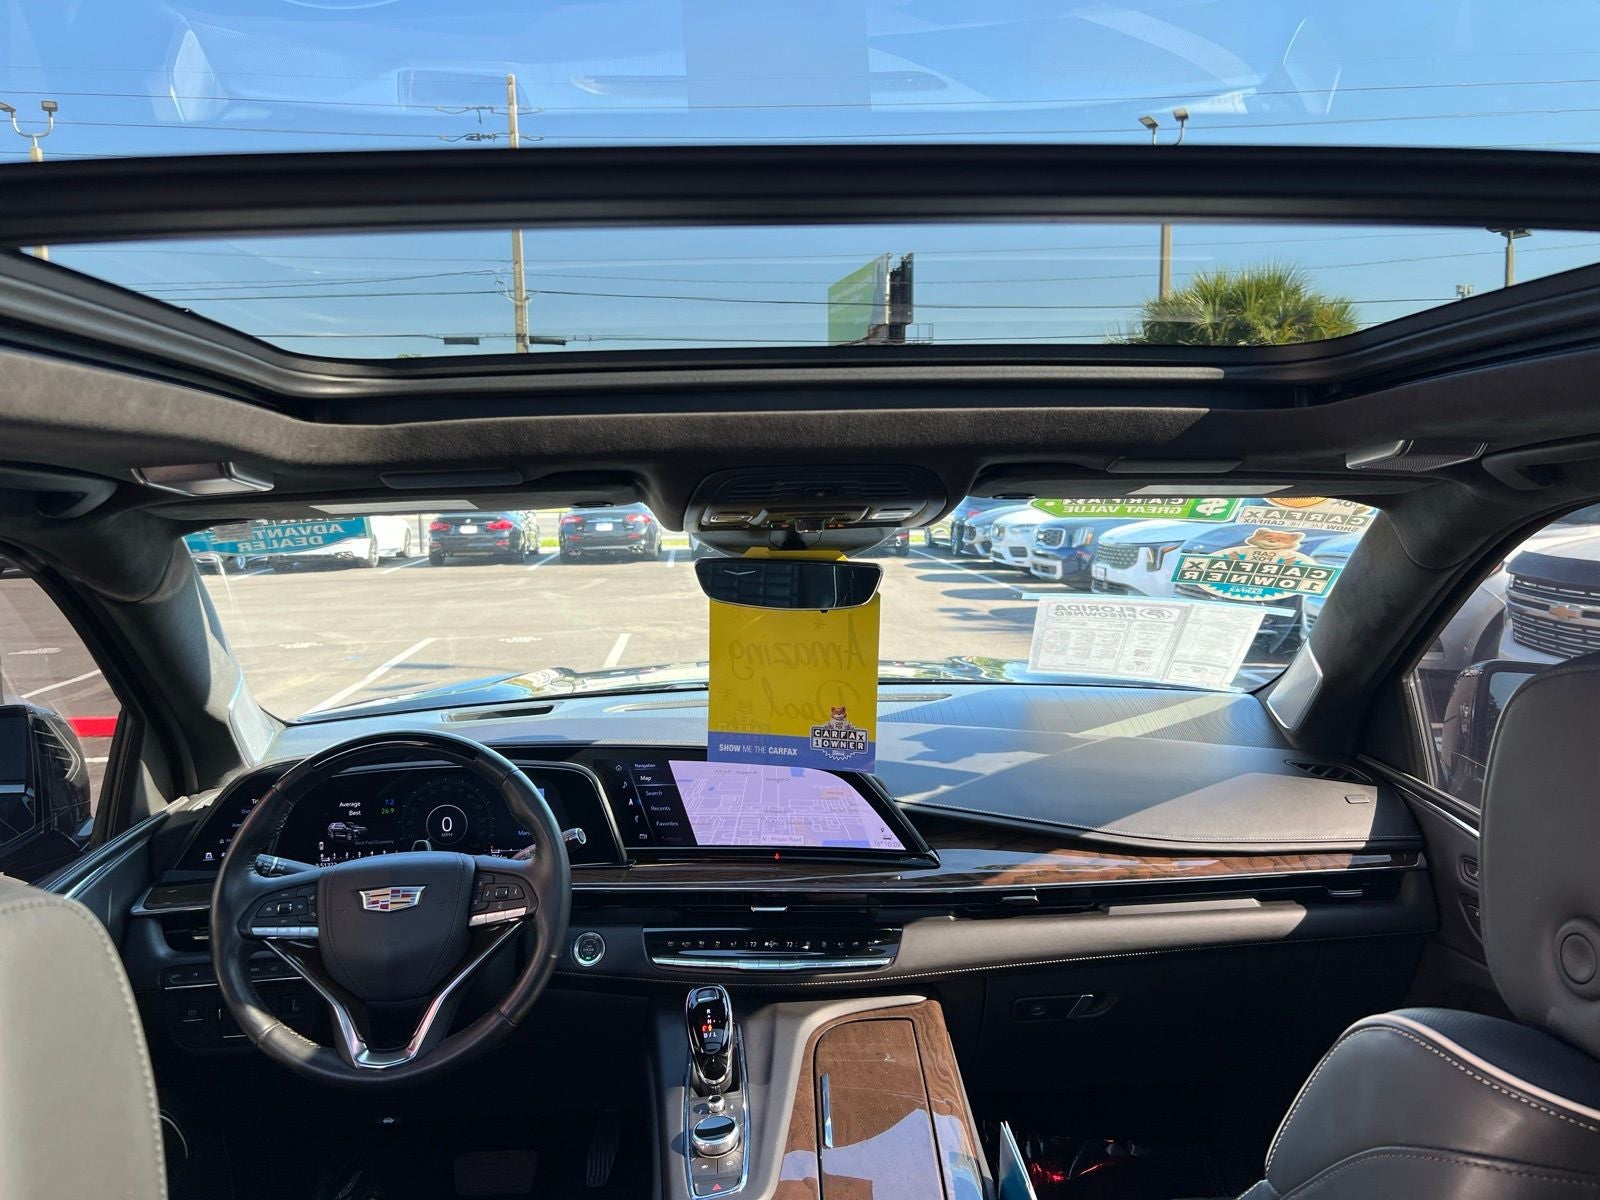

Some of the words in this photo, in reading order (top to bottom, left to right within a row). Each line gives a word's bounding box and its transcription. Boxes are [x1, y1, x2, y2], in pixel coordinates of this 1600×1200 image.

[814, 729, 864, 741] CARFAX
[719, 743, 741, 752] SHOW
[742, 745, 753, 753] ME
[754, 745, 767, 754] THE
[768, 747, 798, 756] CARFAX
[822, 740, 864, 750] OWNER
[441, 816, 453, 832] 0
